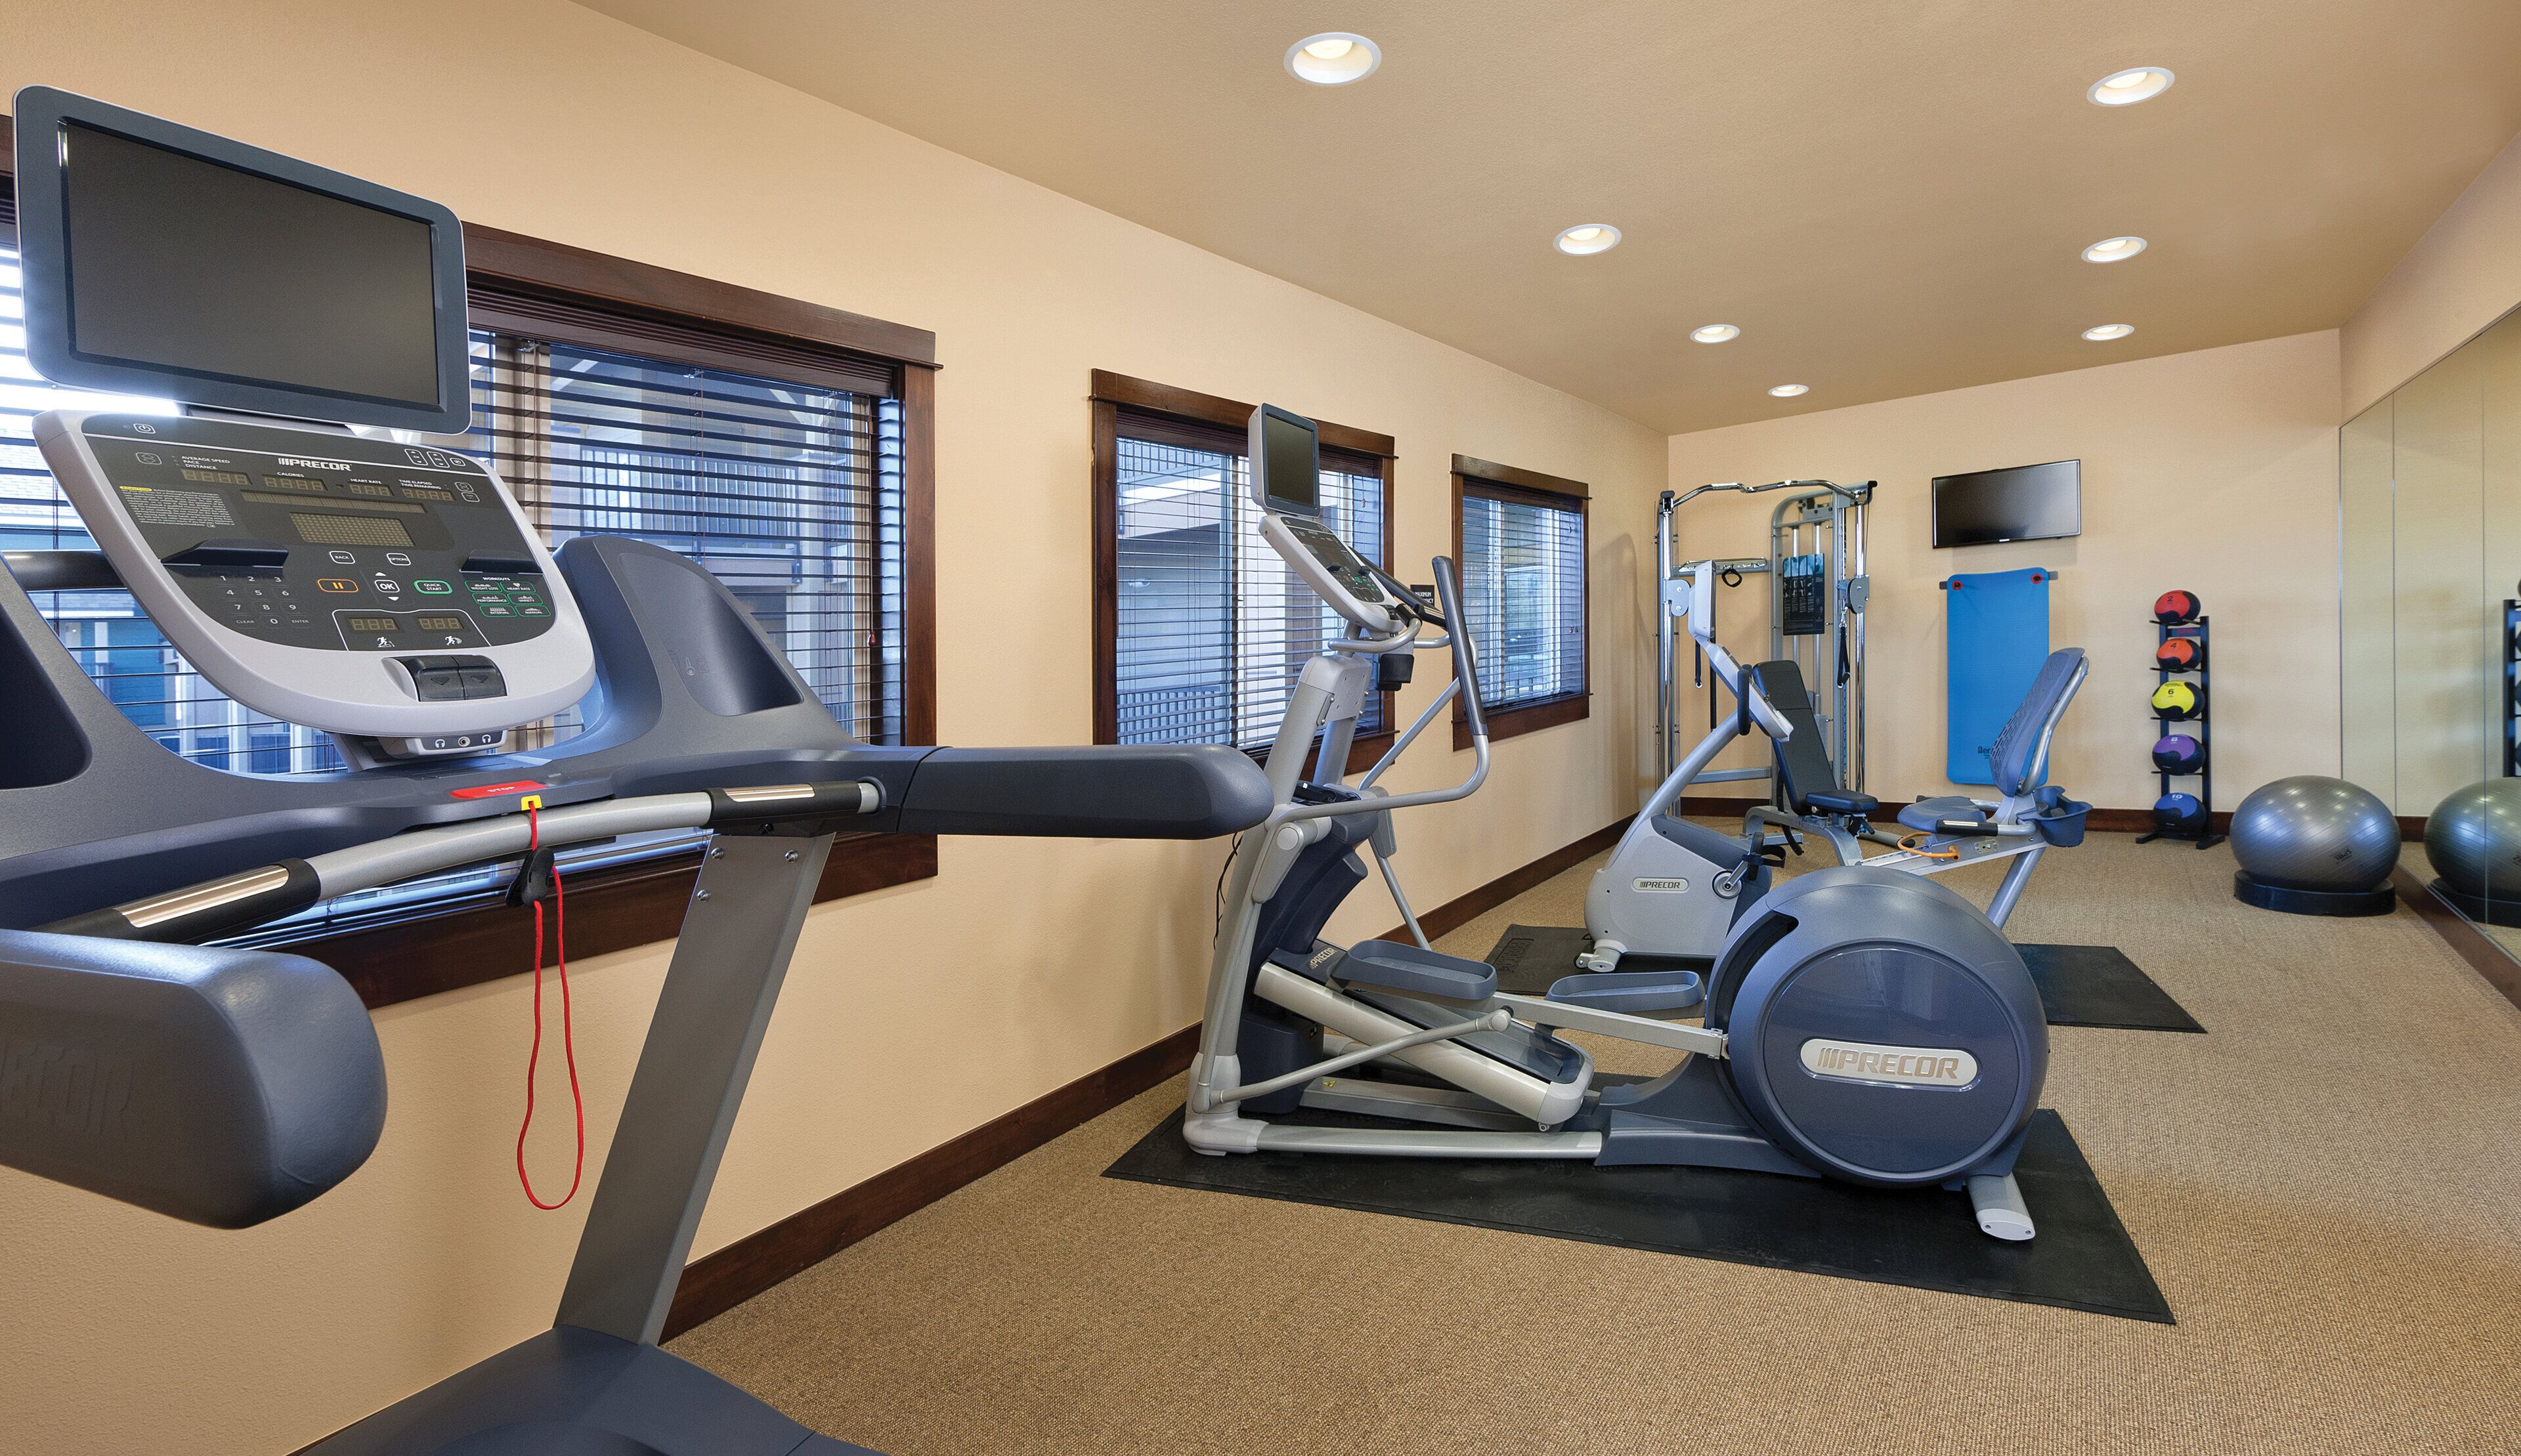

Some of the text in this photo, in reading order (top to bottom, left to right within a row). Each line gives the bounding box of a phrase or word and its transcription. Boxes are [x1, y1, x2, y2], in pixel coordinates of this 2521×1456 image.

[288, 459, 352, 471] PRECOR
[1309, 947, 1338, 968] PRECOR
[1836, 1049, 1959, 1079] PRECOR
